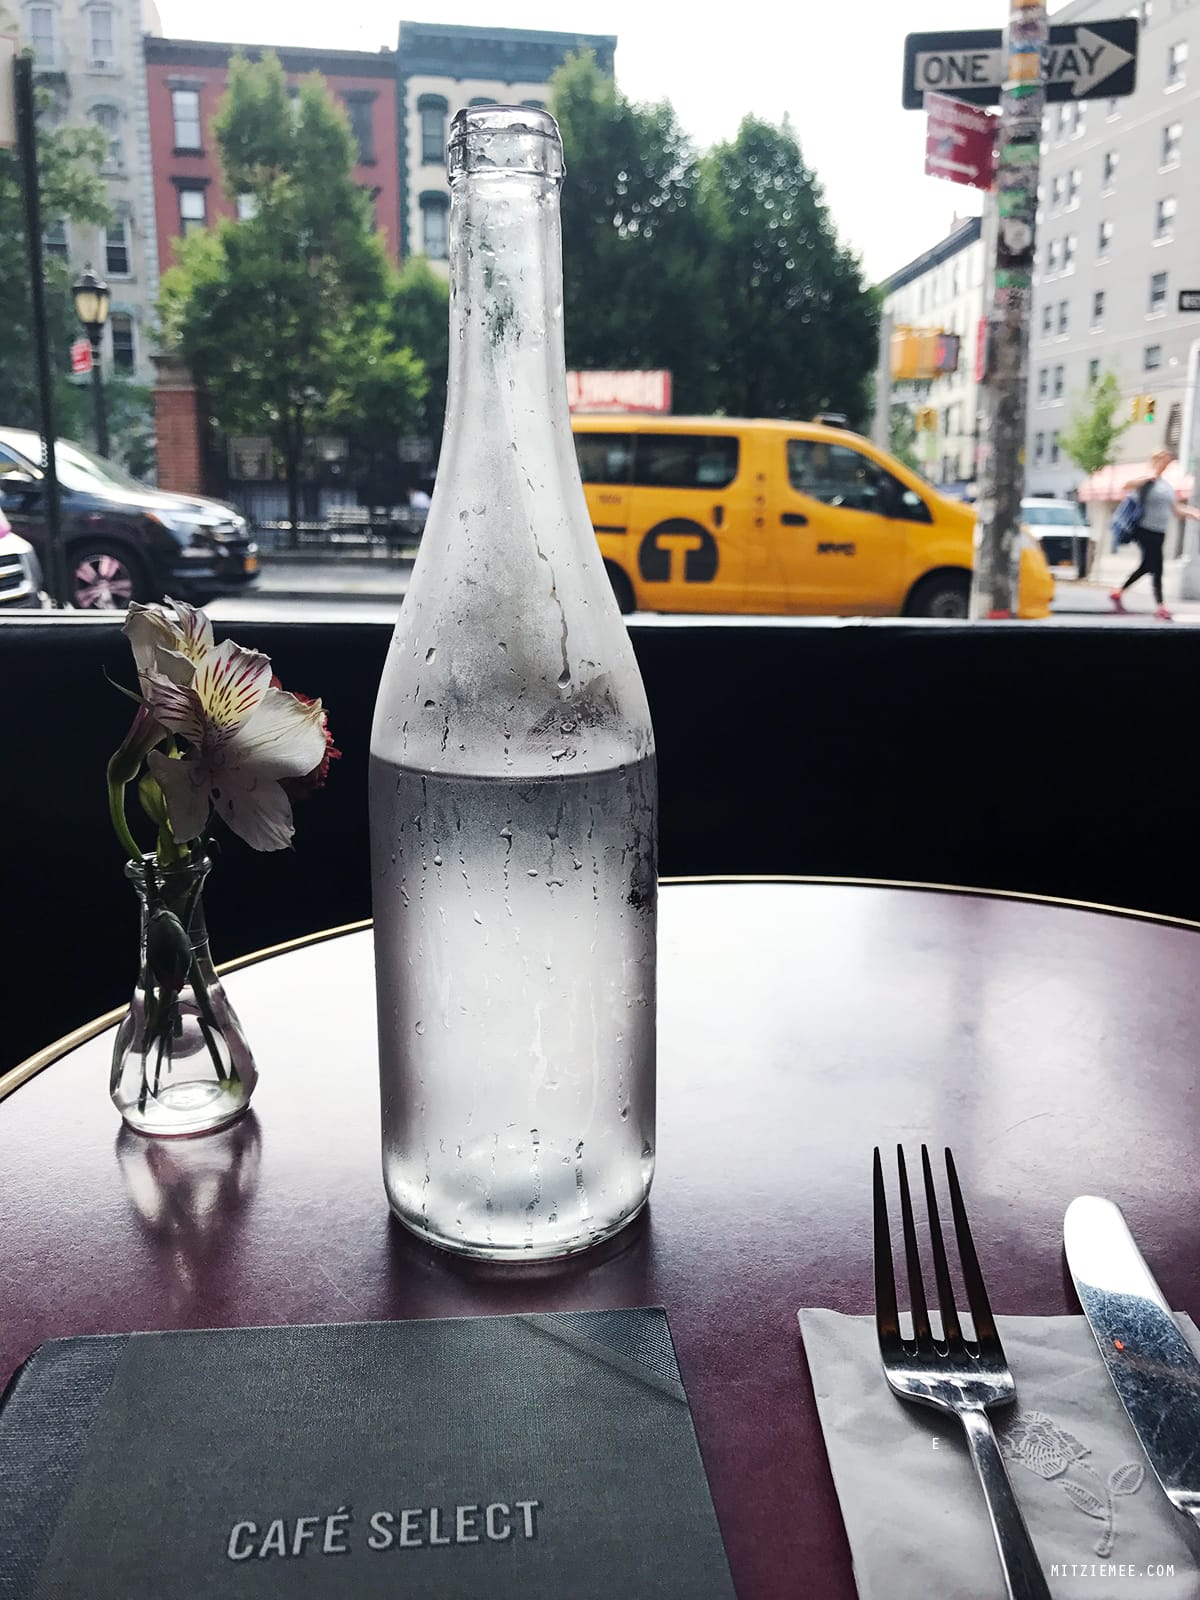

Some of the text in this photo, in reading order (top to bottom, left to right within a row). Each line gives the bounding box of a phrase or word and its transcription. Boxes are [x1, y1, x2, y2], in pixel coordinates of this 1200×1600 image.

[923, 54, 989, 85] ONE
[656, 533, 702, 582] T
[227, 1500, 540, 1561] CAFÉ SELECT
